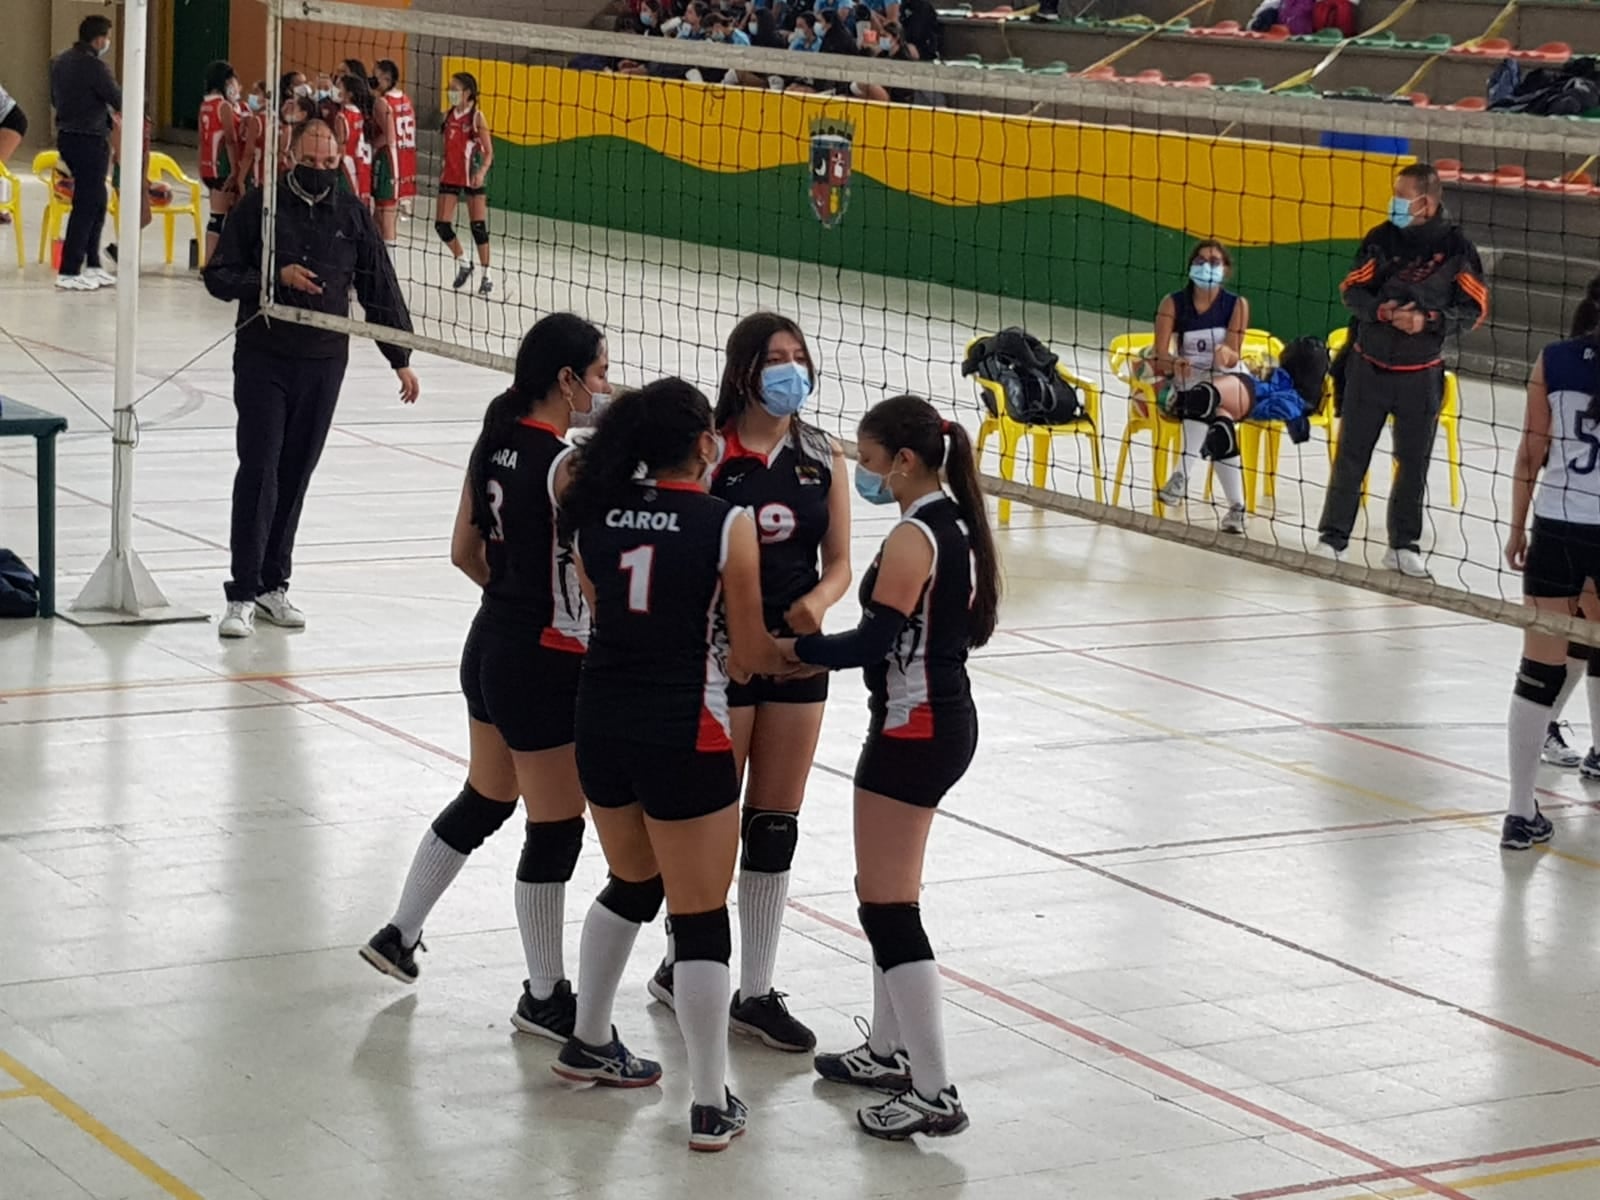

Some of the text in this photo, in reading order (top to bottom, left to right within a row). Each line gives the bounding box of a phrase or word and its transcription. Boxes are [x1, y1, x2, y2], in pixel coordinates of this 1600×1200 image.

[490, 448, 518, 470] ARA
[1567, 409, 1600, 475] 5
[605, 508, 681, 532] CAROL
[618, 544, 655, 614] 1
